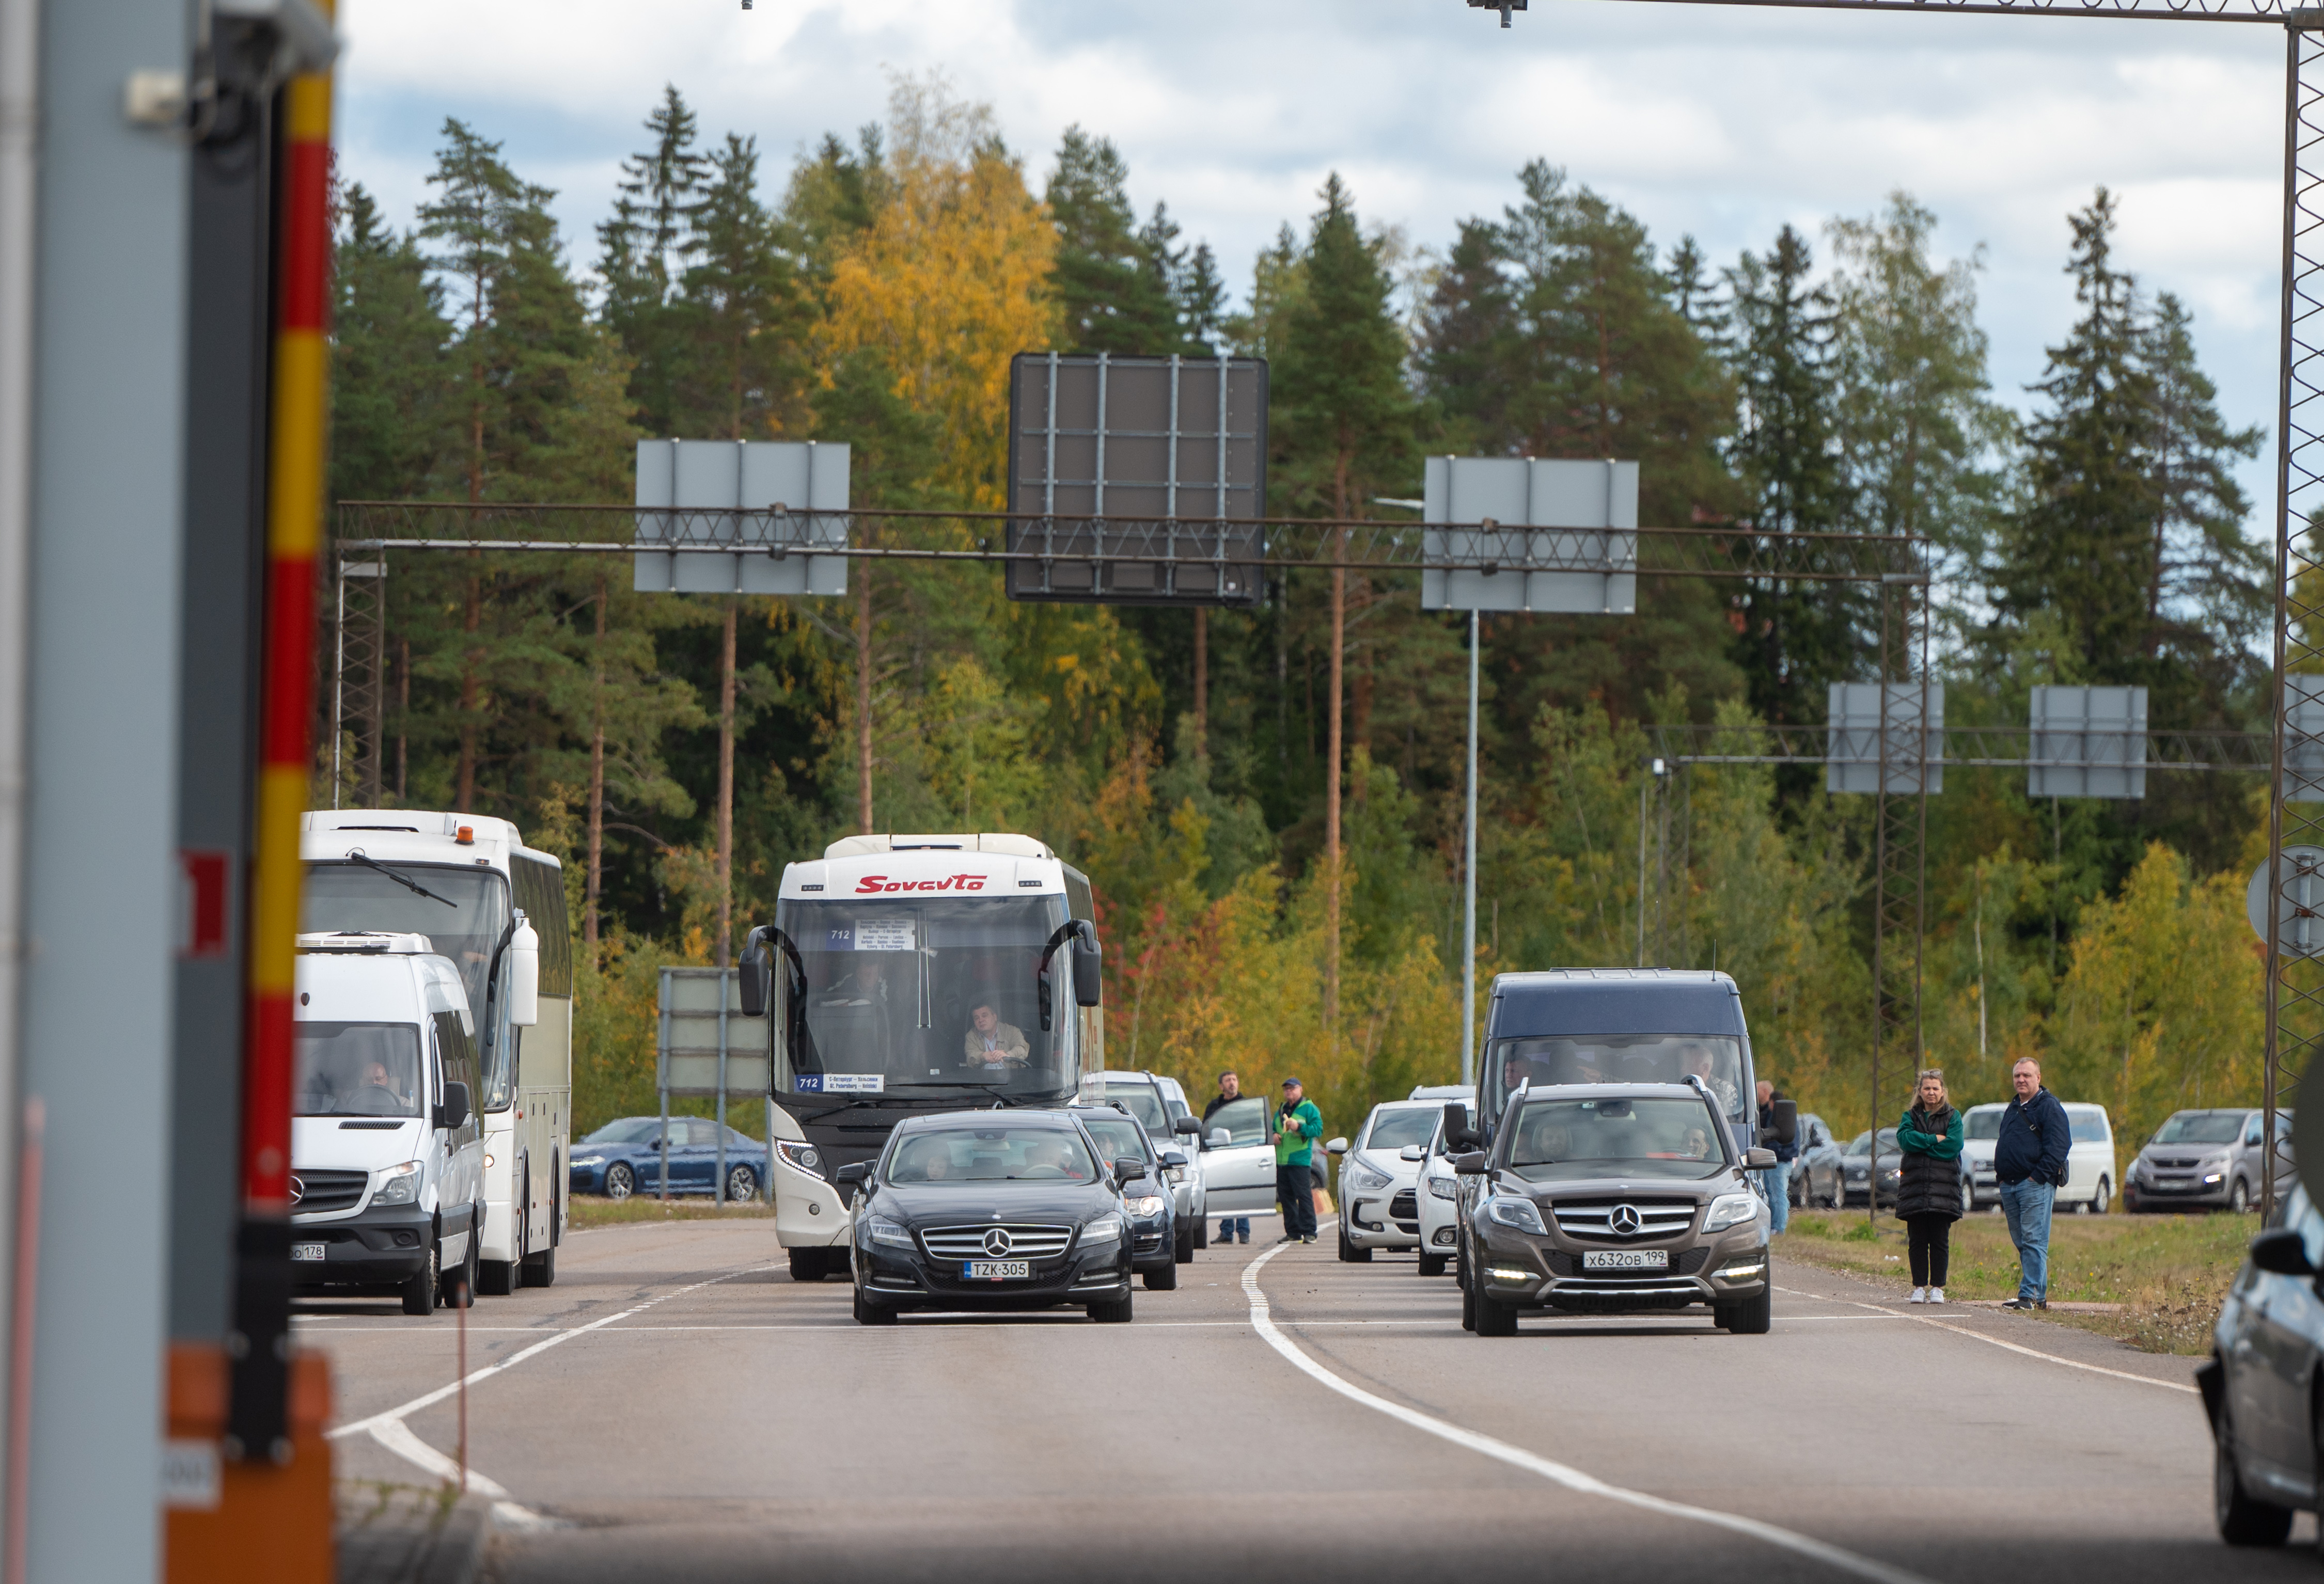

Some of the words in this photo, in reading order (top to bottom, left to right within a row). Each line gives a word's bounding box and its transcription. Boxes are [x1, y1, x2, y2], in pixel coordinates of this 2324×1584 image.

[854, 874, 987, 893] Sovavto
[831, 930, 850, 939] 712
[800, 1078, 818, 1088] 712
[305, 1246, 321, 1255] 178
[1645, 1251, 1664, 1261] 199
